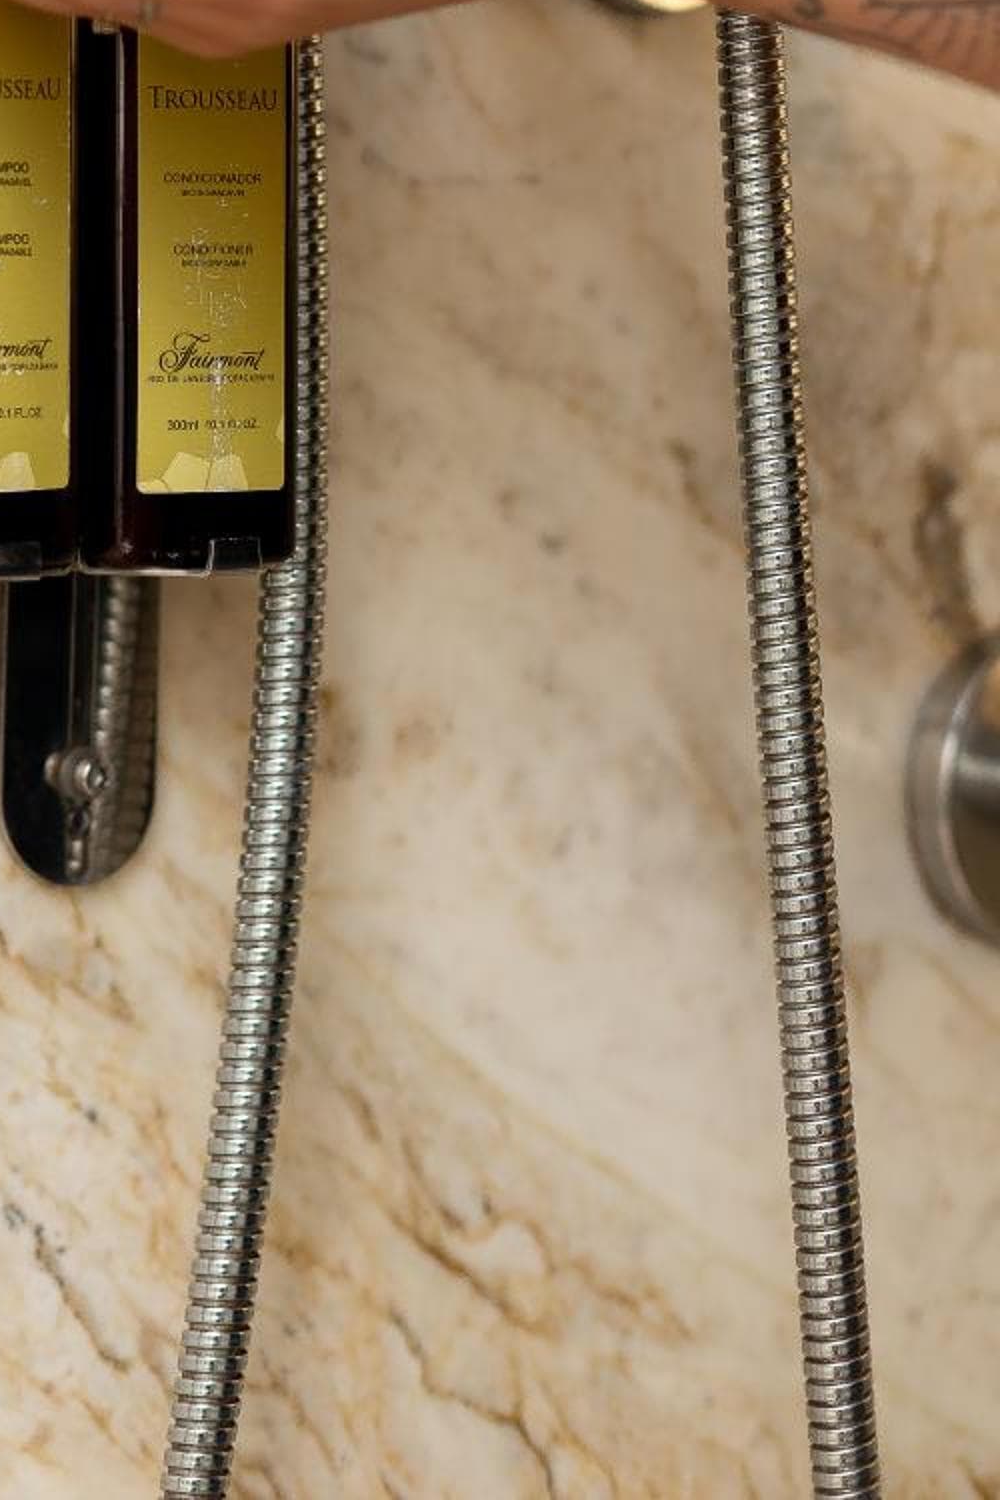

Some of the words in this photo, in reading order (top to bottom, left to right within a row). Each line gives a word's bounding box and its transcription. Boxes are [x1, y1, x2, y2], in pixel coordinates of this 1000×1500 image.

[147, 85, 278, 111] TROUSSEAU
[159, 331, 265, 373] Fairmont
[167, 419, 199, 431] 300ml
